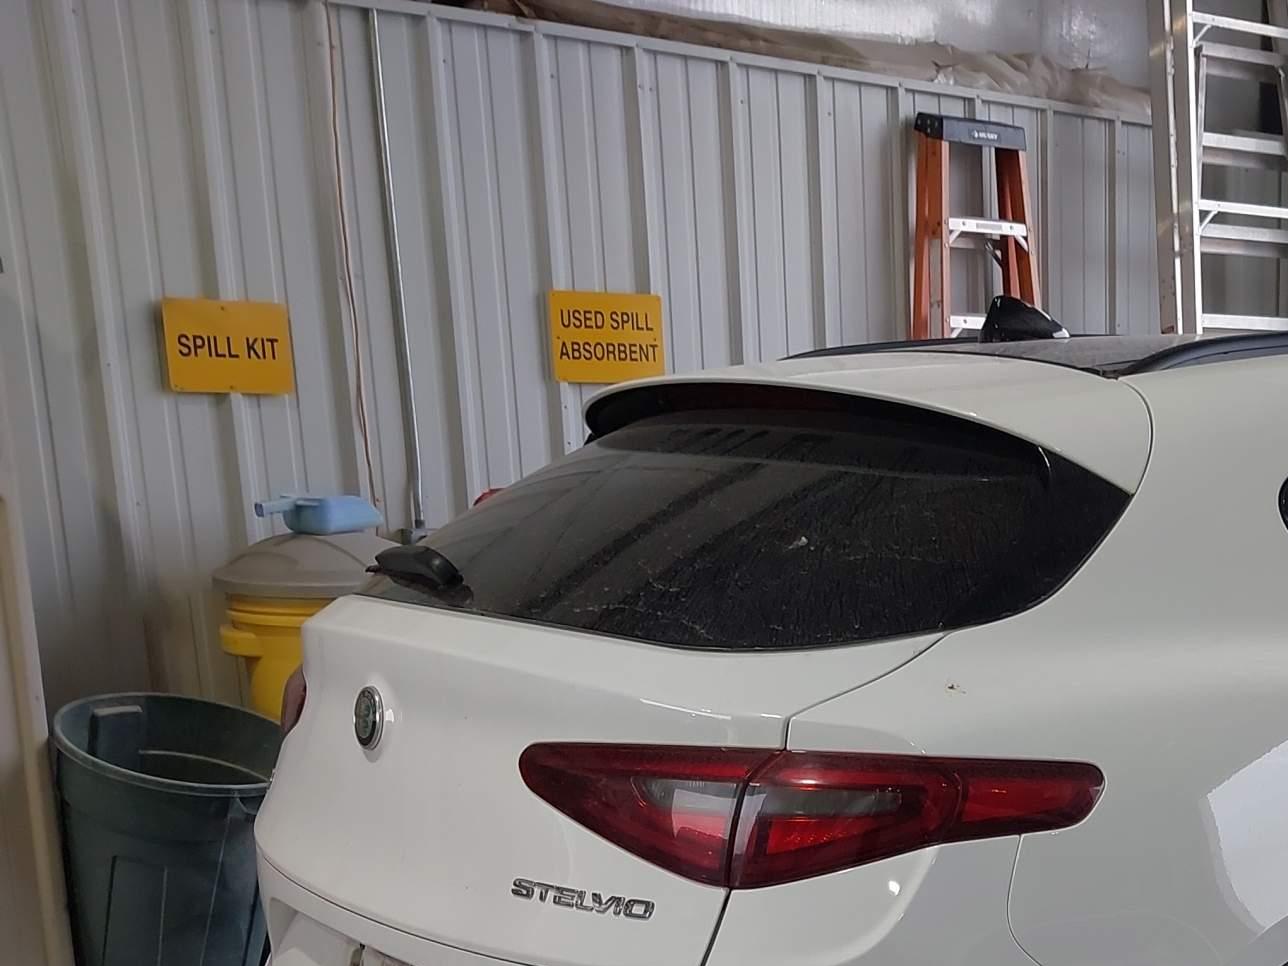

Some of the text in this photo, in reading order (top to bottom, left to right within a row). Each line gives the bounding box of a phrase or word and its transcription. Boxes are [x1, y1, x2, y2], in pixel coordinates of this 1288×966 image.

[560, 308, 654, 331] USED SPILL
[177, 333, 279, 360] SPILL KIT
[559, 341, 659, 363] ABSORBENT
[511, 878, 655, 920] STELVIO
